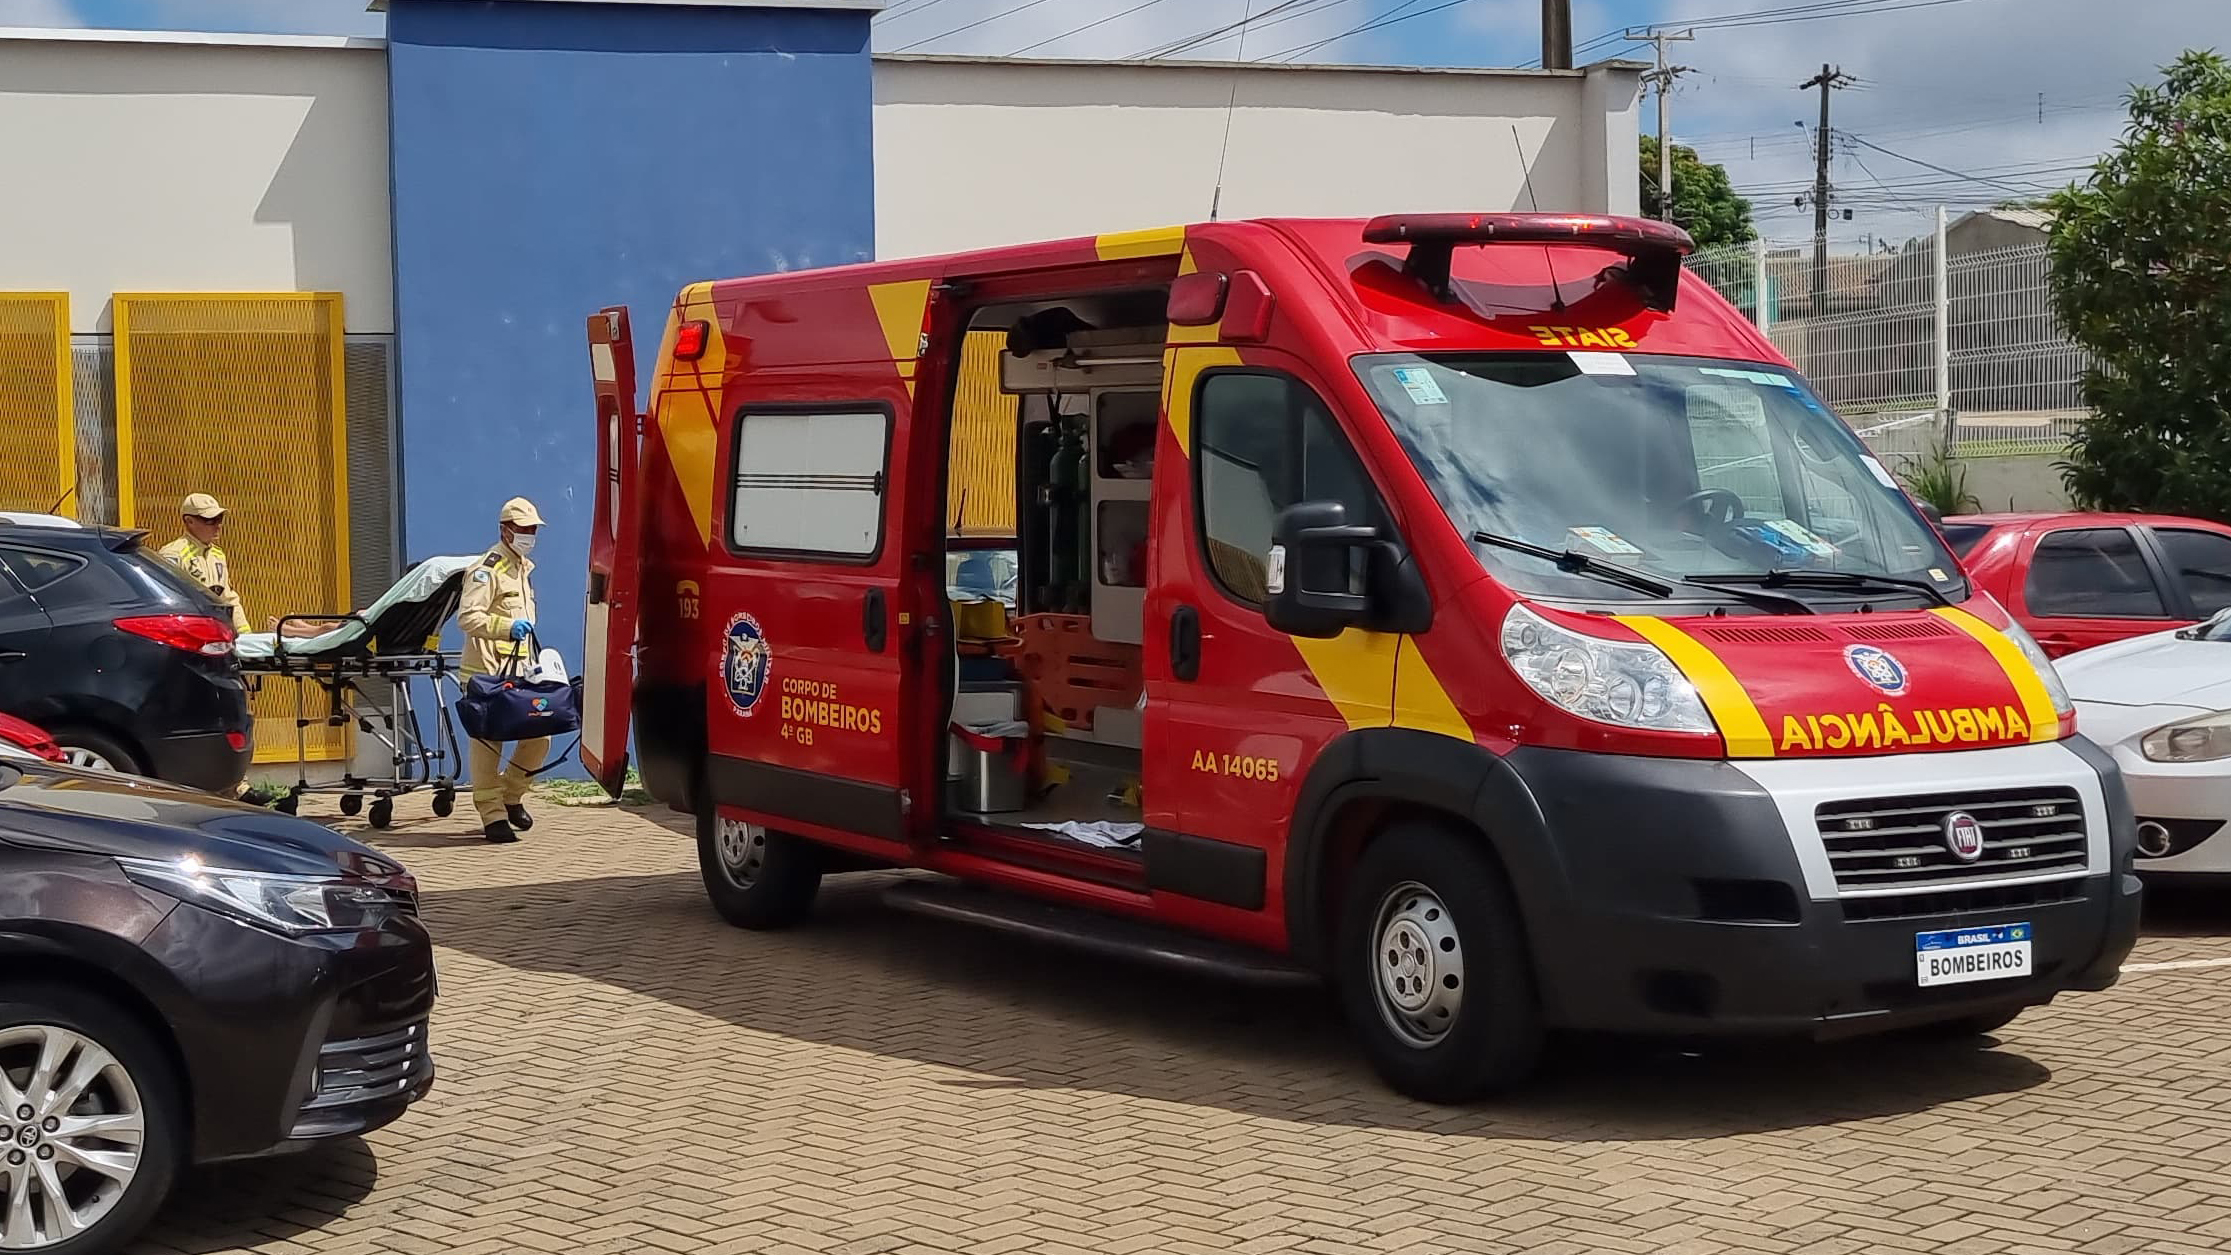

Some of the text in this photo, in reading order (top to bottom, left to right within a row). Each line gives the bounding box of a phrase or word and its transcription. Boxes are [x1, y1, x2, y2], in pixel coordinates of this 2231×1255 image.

[678, 598, 699, 619] 193
[782, 678, 837, 700] CORPO DE
[782, 696, 881, 734] BOMBEIROS
[796, 726, 814, 746] GB
[1191, 750, 1279, 782] AA 14065
[1955, 826, 1977, 849] FIAT
[1957, 932, 1991, 945] BRASIL
[1930, 949, 2024, 977] BOMBEIROS
